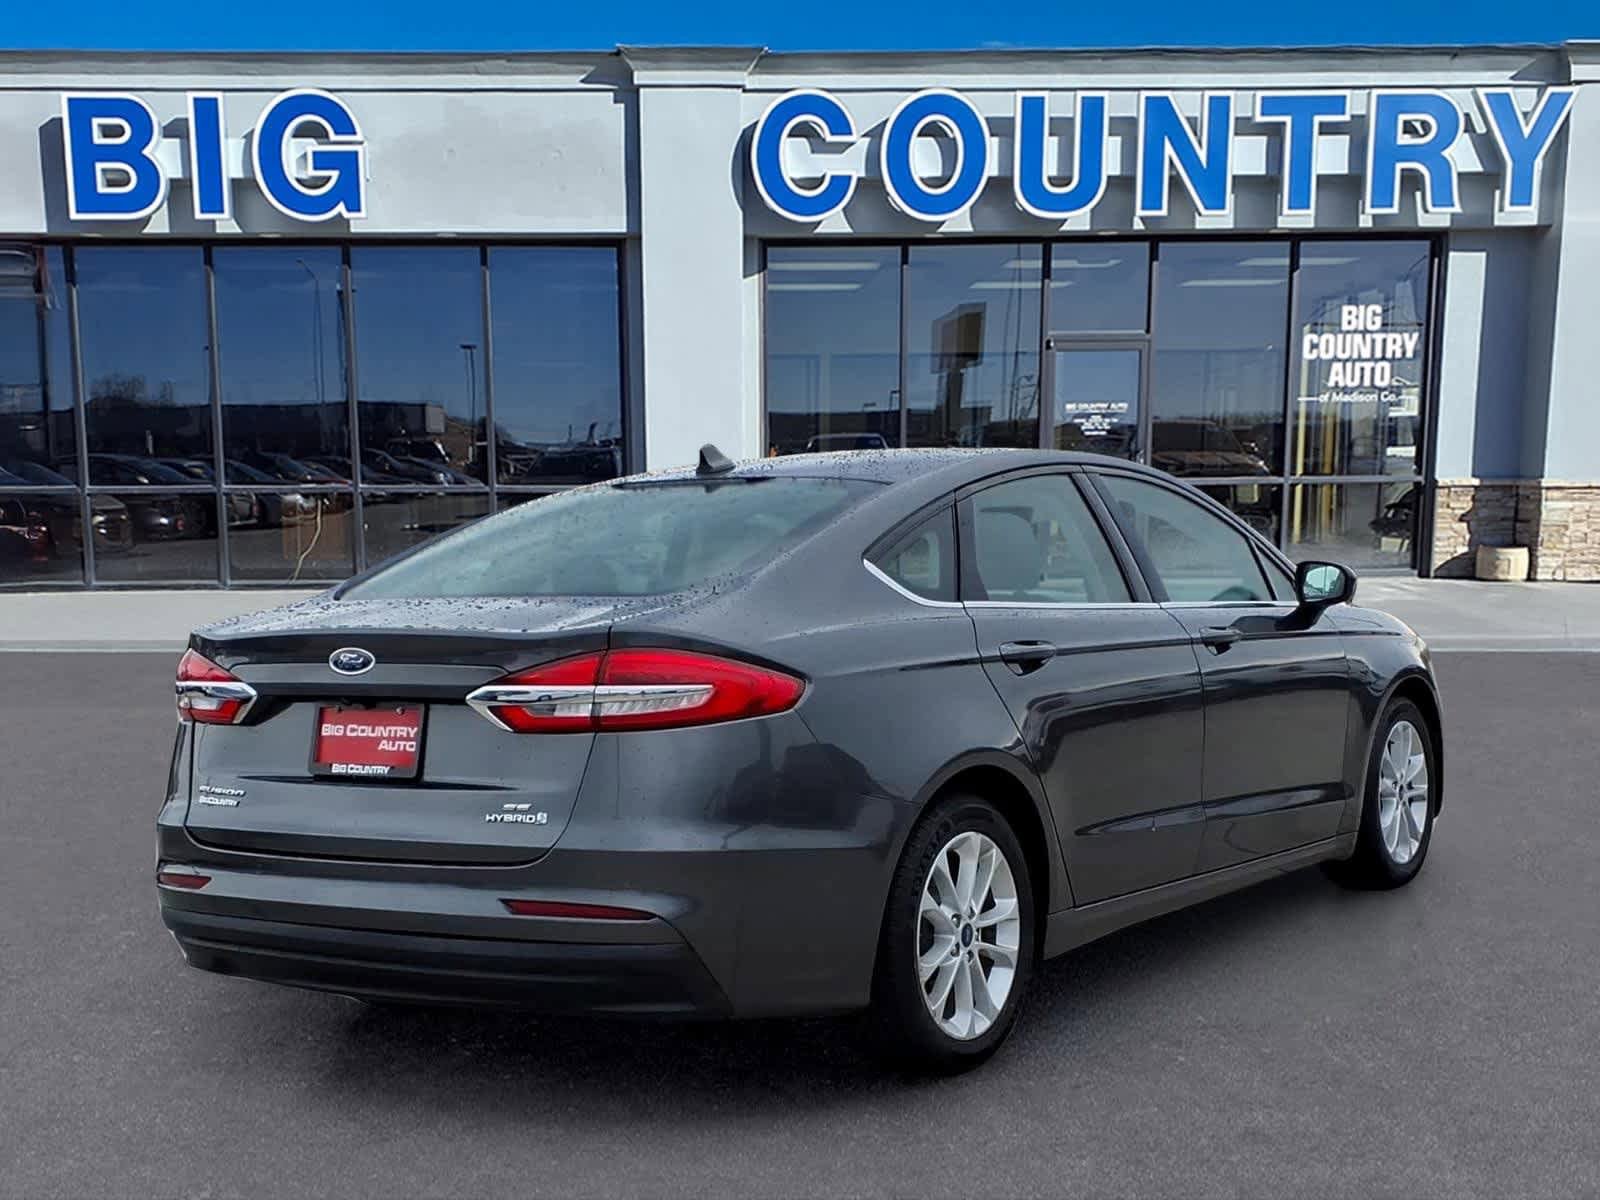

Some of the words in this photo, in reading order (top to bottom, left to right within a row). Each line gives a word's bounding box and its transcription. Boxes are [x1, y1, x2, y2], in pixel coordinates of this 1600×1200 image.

[60, 88, 367, 221] BIG
[750, 86, 1577, 223] COUNTRY
[1341, 304, 1382, 331] BIG
[1302, 332, 1419, 360] COUNTRY
[1327, 361, 1391, 388] AUTO
[1331, 391, 1379, 403] Madison
[321, 723, 345, 737] BIG
[346, 724, 418, 738] COUNTRY
[378, 740, 416, 752] AUTO
[485, 813, 536, 823] HYBRID
